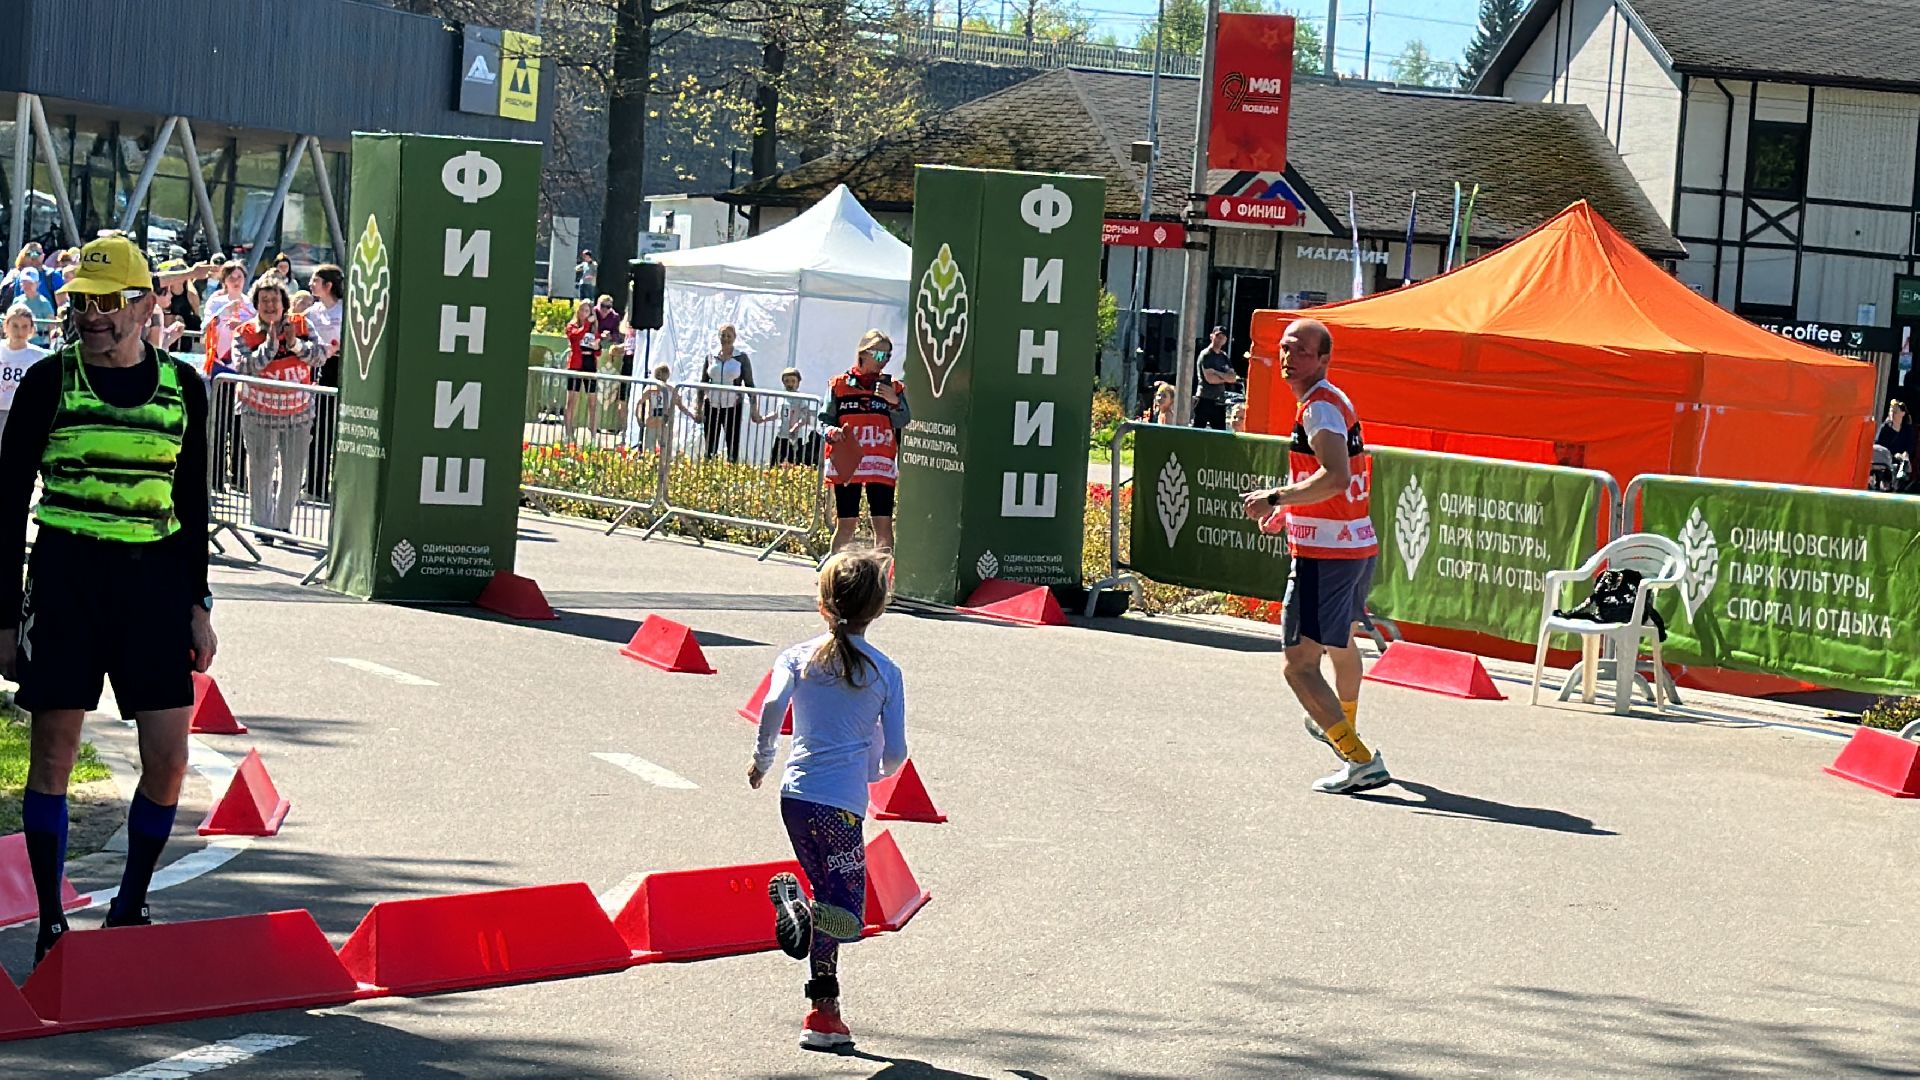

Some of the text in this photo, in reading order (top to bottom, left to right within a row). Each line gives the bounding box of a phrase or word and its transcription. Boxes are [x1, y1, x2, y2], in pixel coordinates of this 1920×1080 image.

[1249, 77, 1281, 94] МАЯ
[1242, 104, 1279, 115] ПОБЕДА!
[1237, 203, 1286, 219] ФИНИШ
[83, 252, 111, 265] LCL
[420, 151, 502, 505] ФИНИШ
[1782, 323, 1842, 343] coffee
[1001, 183, 1072, 518] ФИНИШ
[871, 400, 887, 410] Spo
[853, 425, 893, 447] ДЬЯ
[903, 435, 922, 448] ПАРК
[903, 452, 928, 467] СПОРТА
[936, 458, 965, 473] ОТДЫХА
[1197, 497, 1226, 518] ПАРК
[1440, 492, 1545, 527] ОДИНЦОВСКИЙ
[1197, 525, 1244, 549] СПОРТА
[1246, 529, 1255, 551] И
[1439, 524, 1551, 562] ПАРК КУЛЬТУРЫ,
[1730, 526, 1867, 562] ОДИНЦОВСКИЙ
[422, 543, 490, 555] ОДИНЦОВСКИЙ
[1003, 553, 1063, 564] ОДИНЦОВСКИЙ
[421, 555, 494, 567] ПАРК КУЛЬТУРЫ,
[1003, 565, 1023, 574] ПАРК
[420, 566, 495, 578] СПОРТА И ОТДЫХ
[1437, 557, 1545, 595] СПОРТА И ОТДЫ
[1729, 561, 1875, 603] ПАРК КУЛЬТУРЫ,
[1727, 597, 1892, 639] СПОРТА И ОТДЫХА
